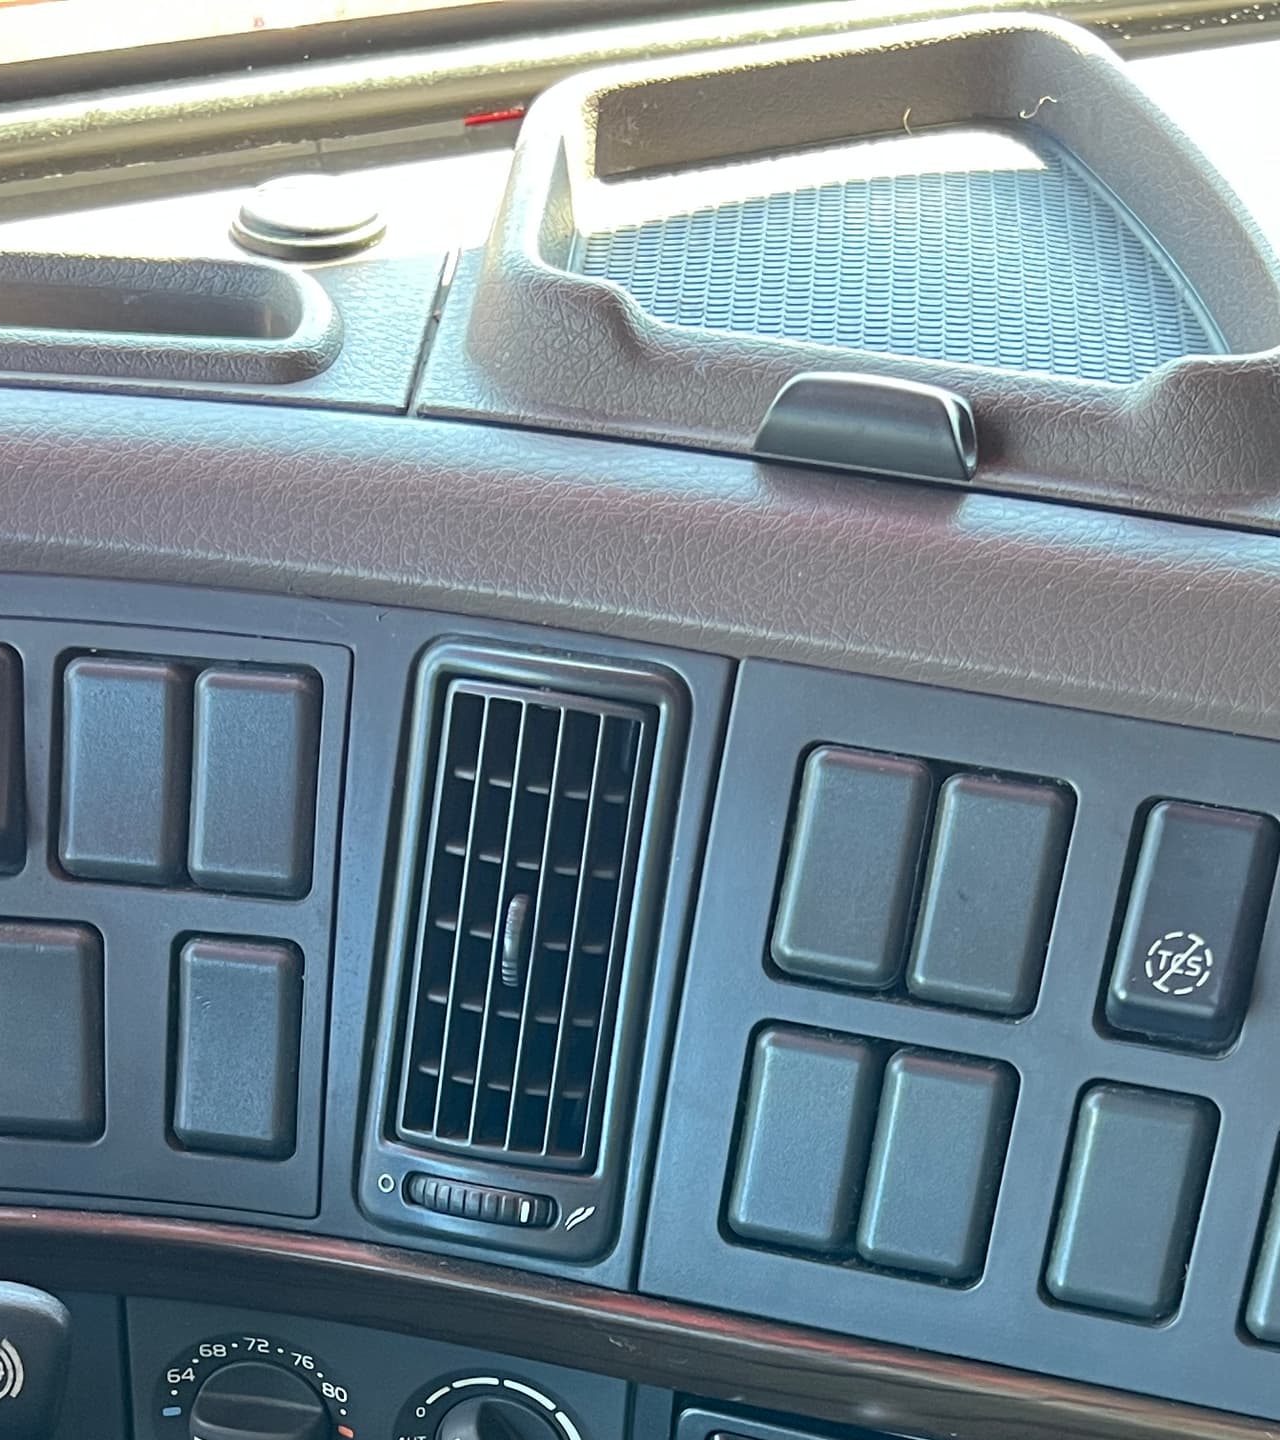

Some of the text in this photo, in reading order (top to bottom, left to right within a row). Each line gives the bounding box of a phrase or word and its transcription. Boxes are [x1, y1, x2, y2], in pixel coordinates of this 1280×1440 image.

[166, 1337, 348, 1403] 64 68 72 76 80
